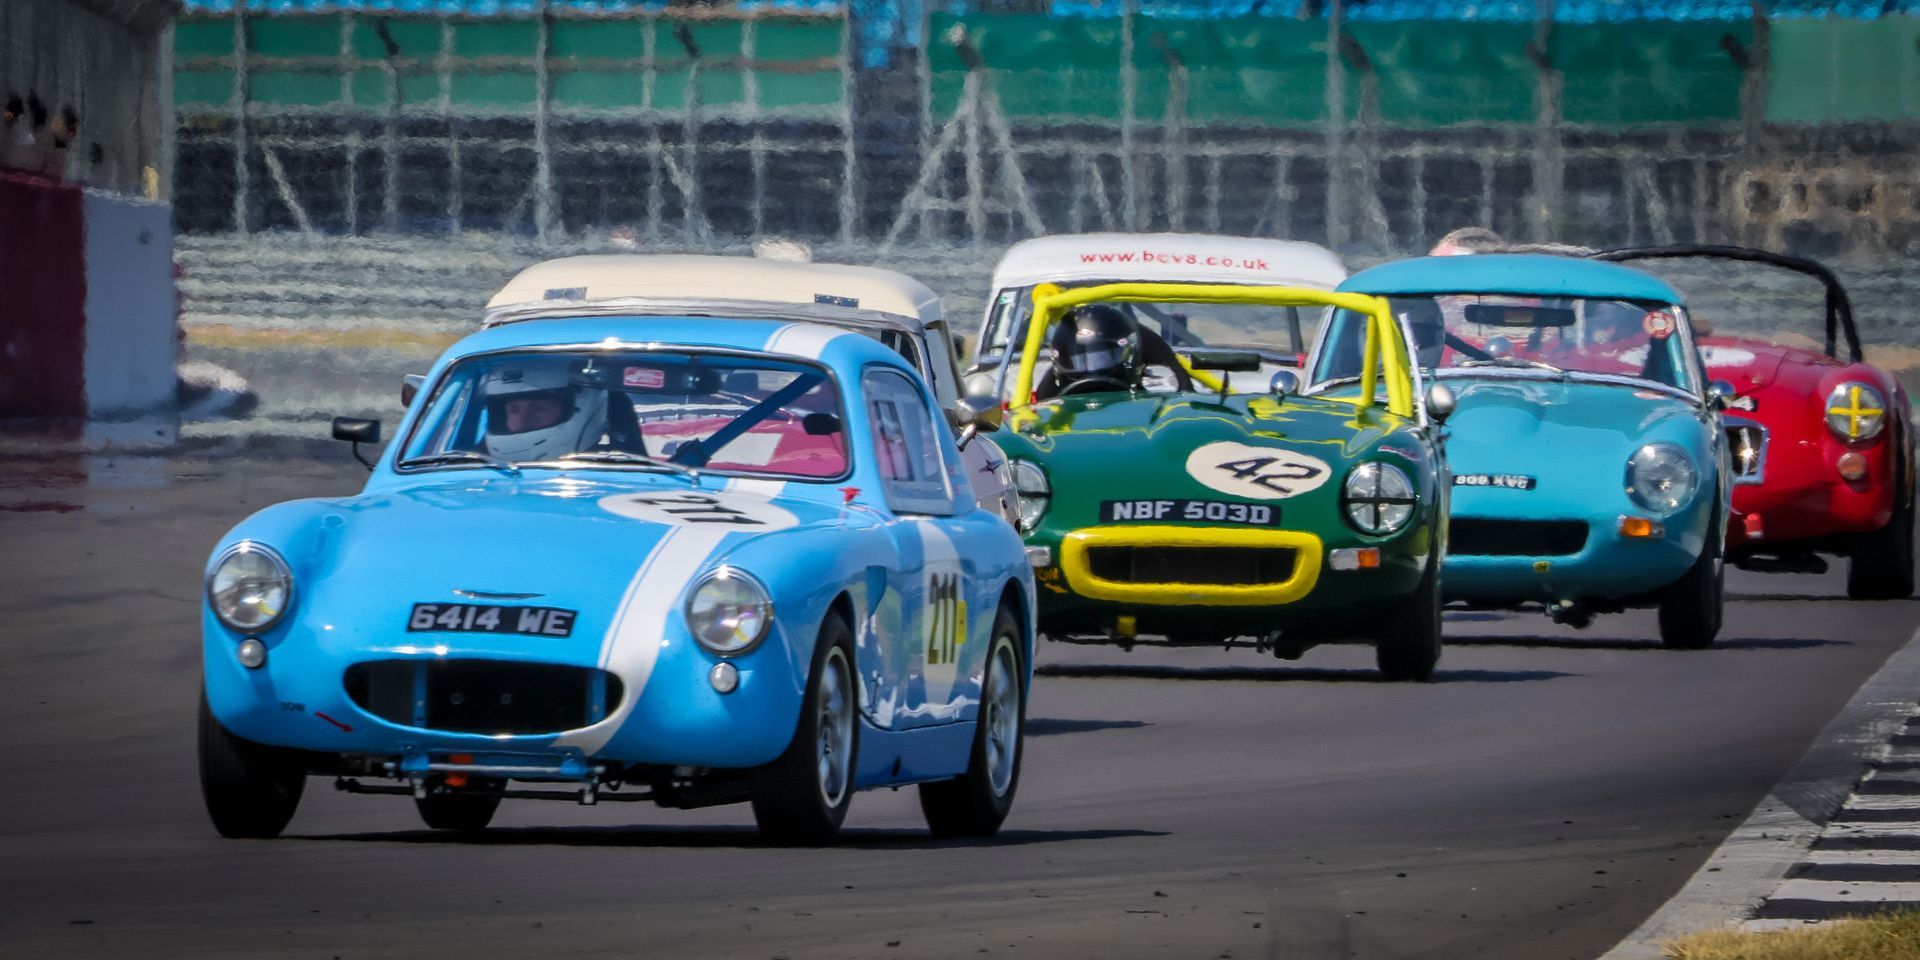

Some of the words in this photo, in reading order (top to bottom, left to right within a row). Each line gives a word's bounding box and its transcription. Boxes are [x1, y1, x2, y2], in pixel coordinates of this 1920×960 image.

[1215, 456, 1323, 495] 42
[629, 494, 768, 525] 211
[1112, 500, 1175, 521] NBF
[1183, 501, 1271, 524] 503D
[410, 604, 500, 630] 6414
[516, 607, 574, 635] WE
[927, 572, 957, 664] 211
